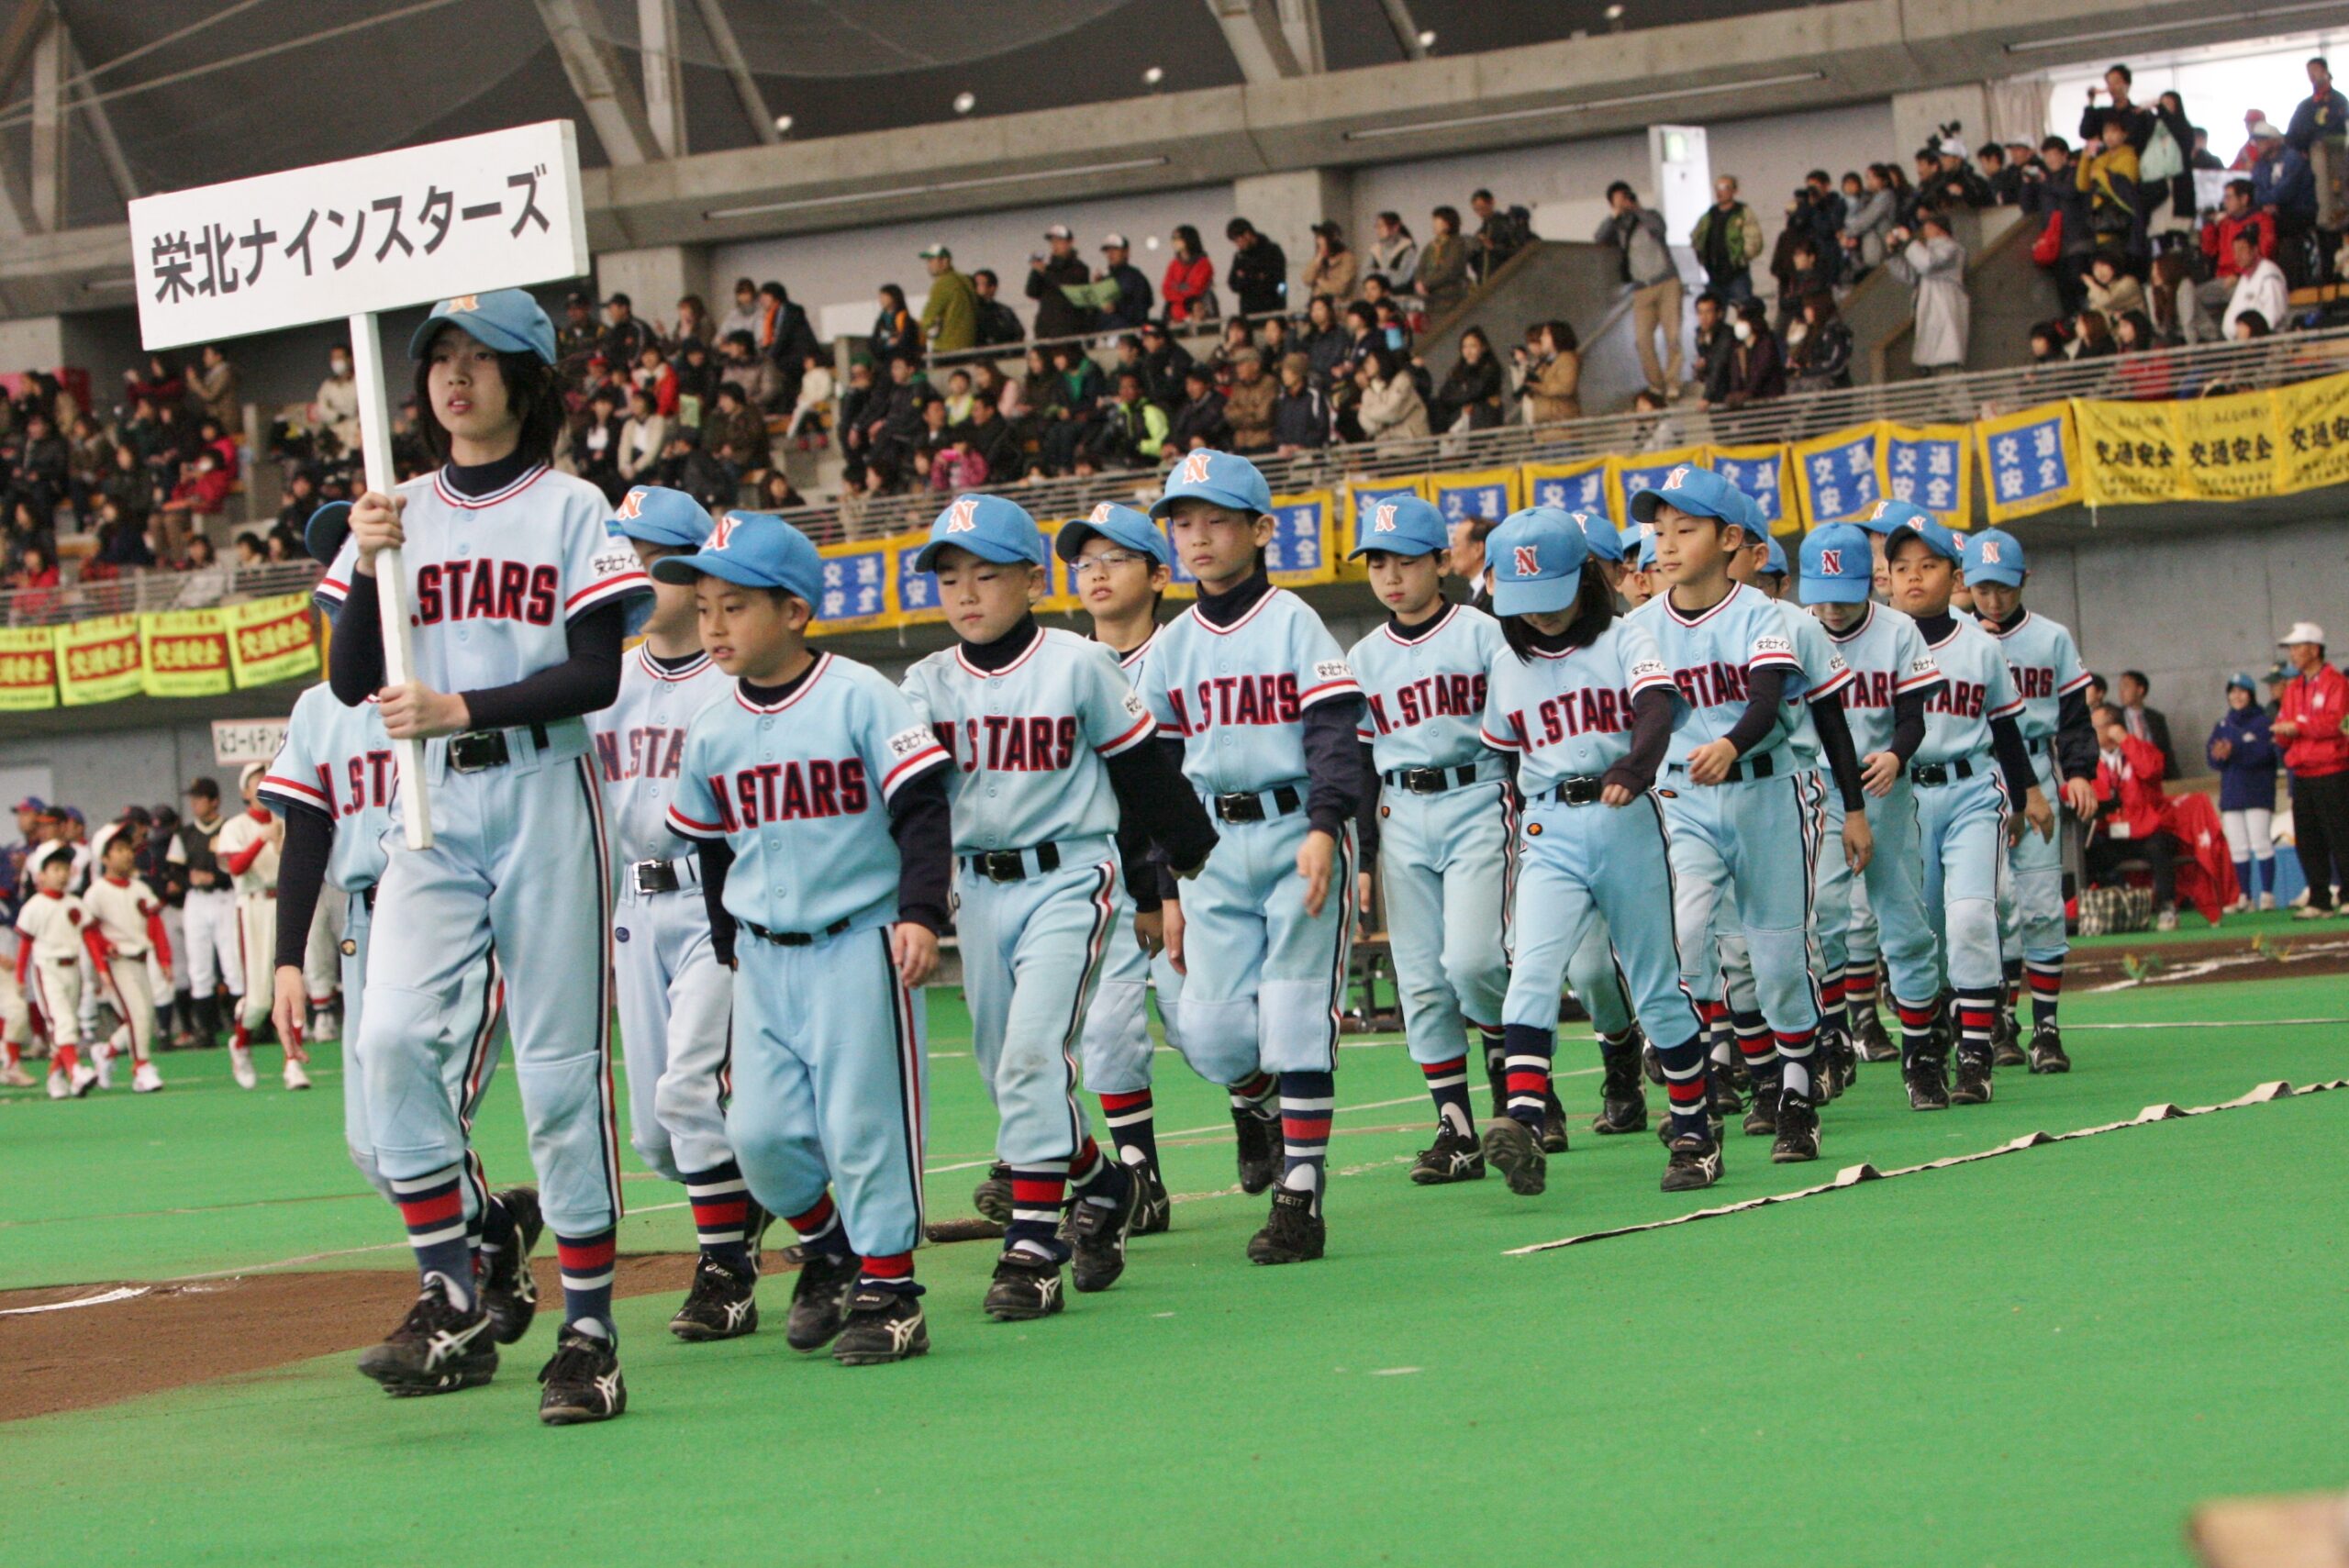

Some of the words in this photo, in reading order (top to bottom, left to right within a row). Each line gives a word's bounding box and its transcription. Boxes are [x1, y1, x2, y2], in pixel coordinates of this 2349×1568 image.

[151, 163, 550, 304] 栄北ナインスターズ
[1895, 446, 1951, 475] 交通
[2095, 440, 2174, 468] 交通安全
[2189, 433, 2273, 468] 交通安全
[1183, 453, 1211, 484] N
[1662, 467, 1689, 491] N
[618, 491, 647, 520] N
[947, 500, 979, 533] N
[1088, 503, 1114, 524] N
[1375, 505, 1397, 531] N
[706, 516, 741, 550] N
[1514, 545, 1541, 576] N
[1821, 550, 1842, 575] N
[1982, 542, 2000, 563] N
[1367, 673, 1486, 736] N.STARS
[316, 750, 398, 820] N.ST
[708, 757, 869, 834] N.STARS
[1276, 1194, 1304, 1207] ZETT
